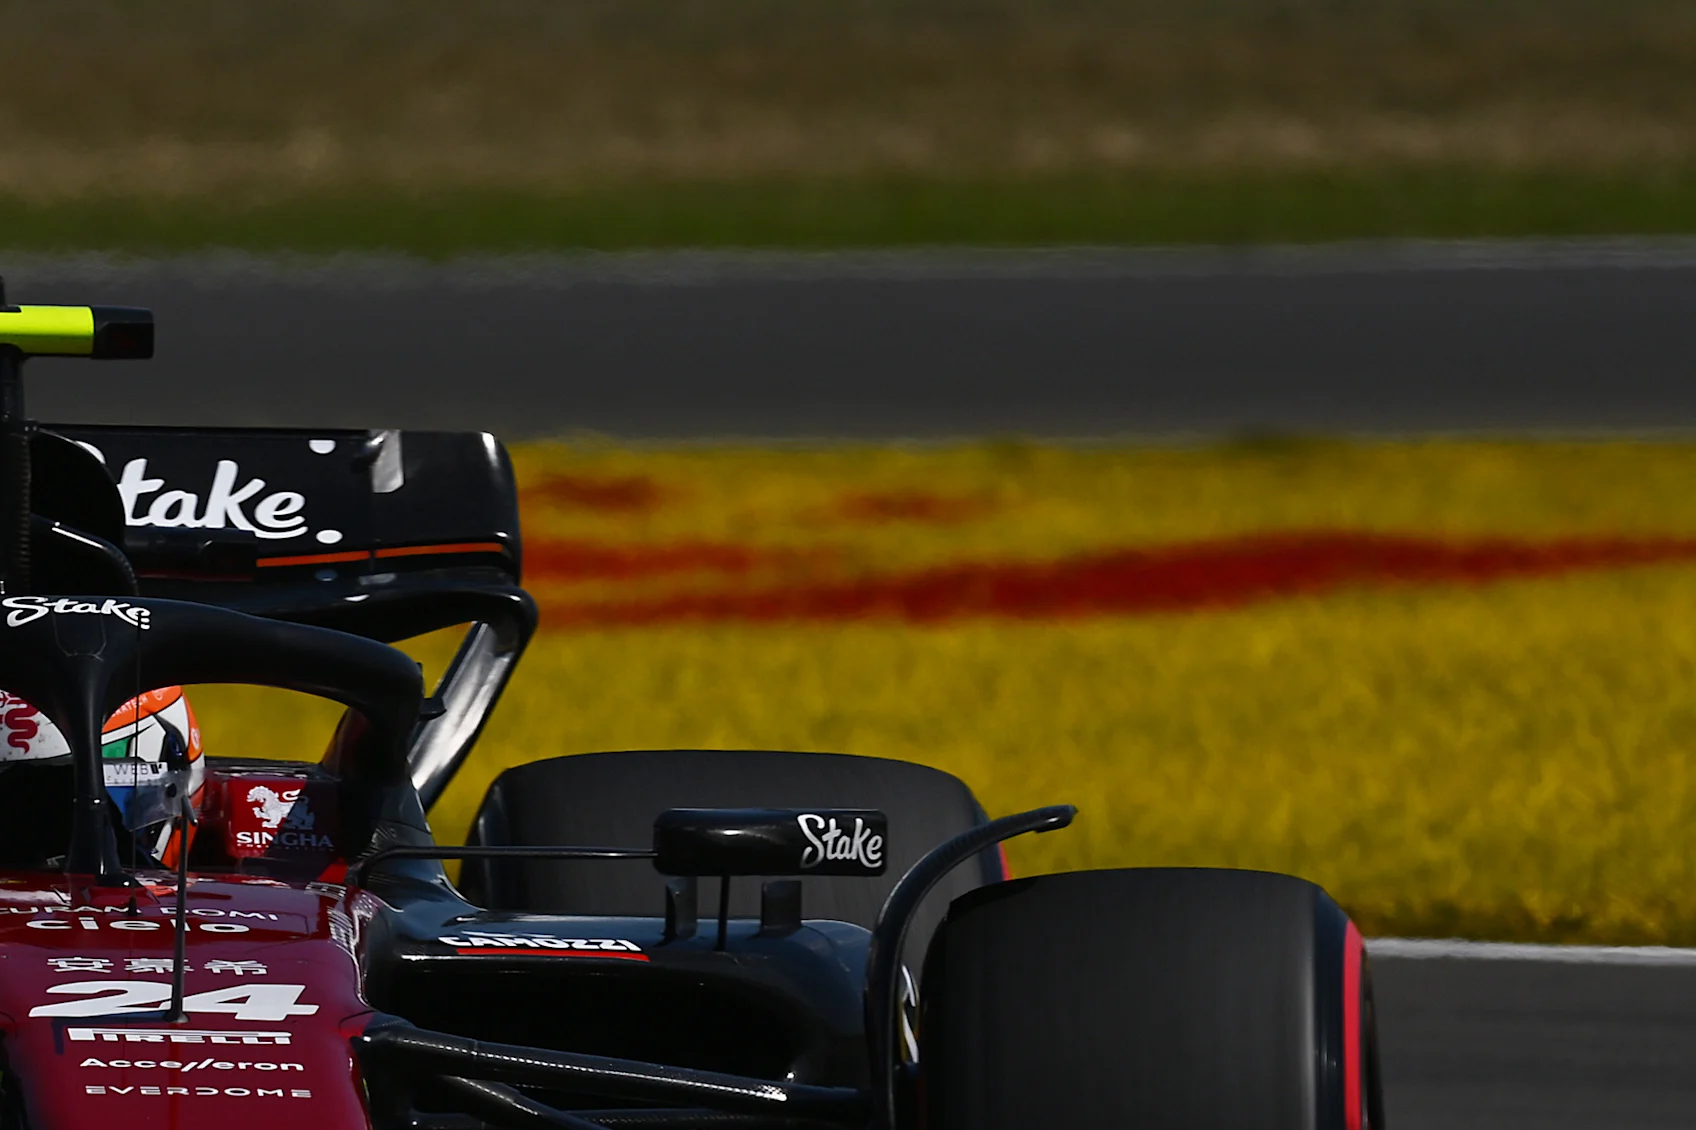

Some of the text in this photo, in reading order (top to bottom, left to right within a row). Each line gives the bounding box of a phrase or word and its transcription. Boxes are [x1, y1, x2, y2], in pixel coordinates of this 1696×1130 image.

[79, 440, 309, 540] take
[2, 596, 151, 630] Stake
[235, 831, 335, 848] SINGHA
[797, 813, 886, 869] Stake
[160, 906, 279, 921] DOMI
[437, 935, 643, 952] CAMOZZI
[28, 979, 320, 1022] 24
[67, 1027, 293, 1045] PIRELLI
[79, 1057, 305, 1073] Accelleron
[84, 1085, 313, 1100] EVERDOME
